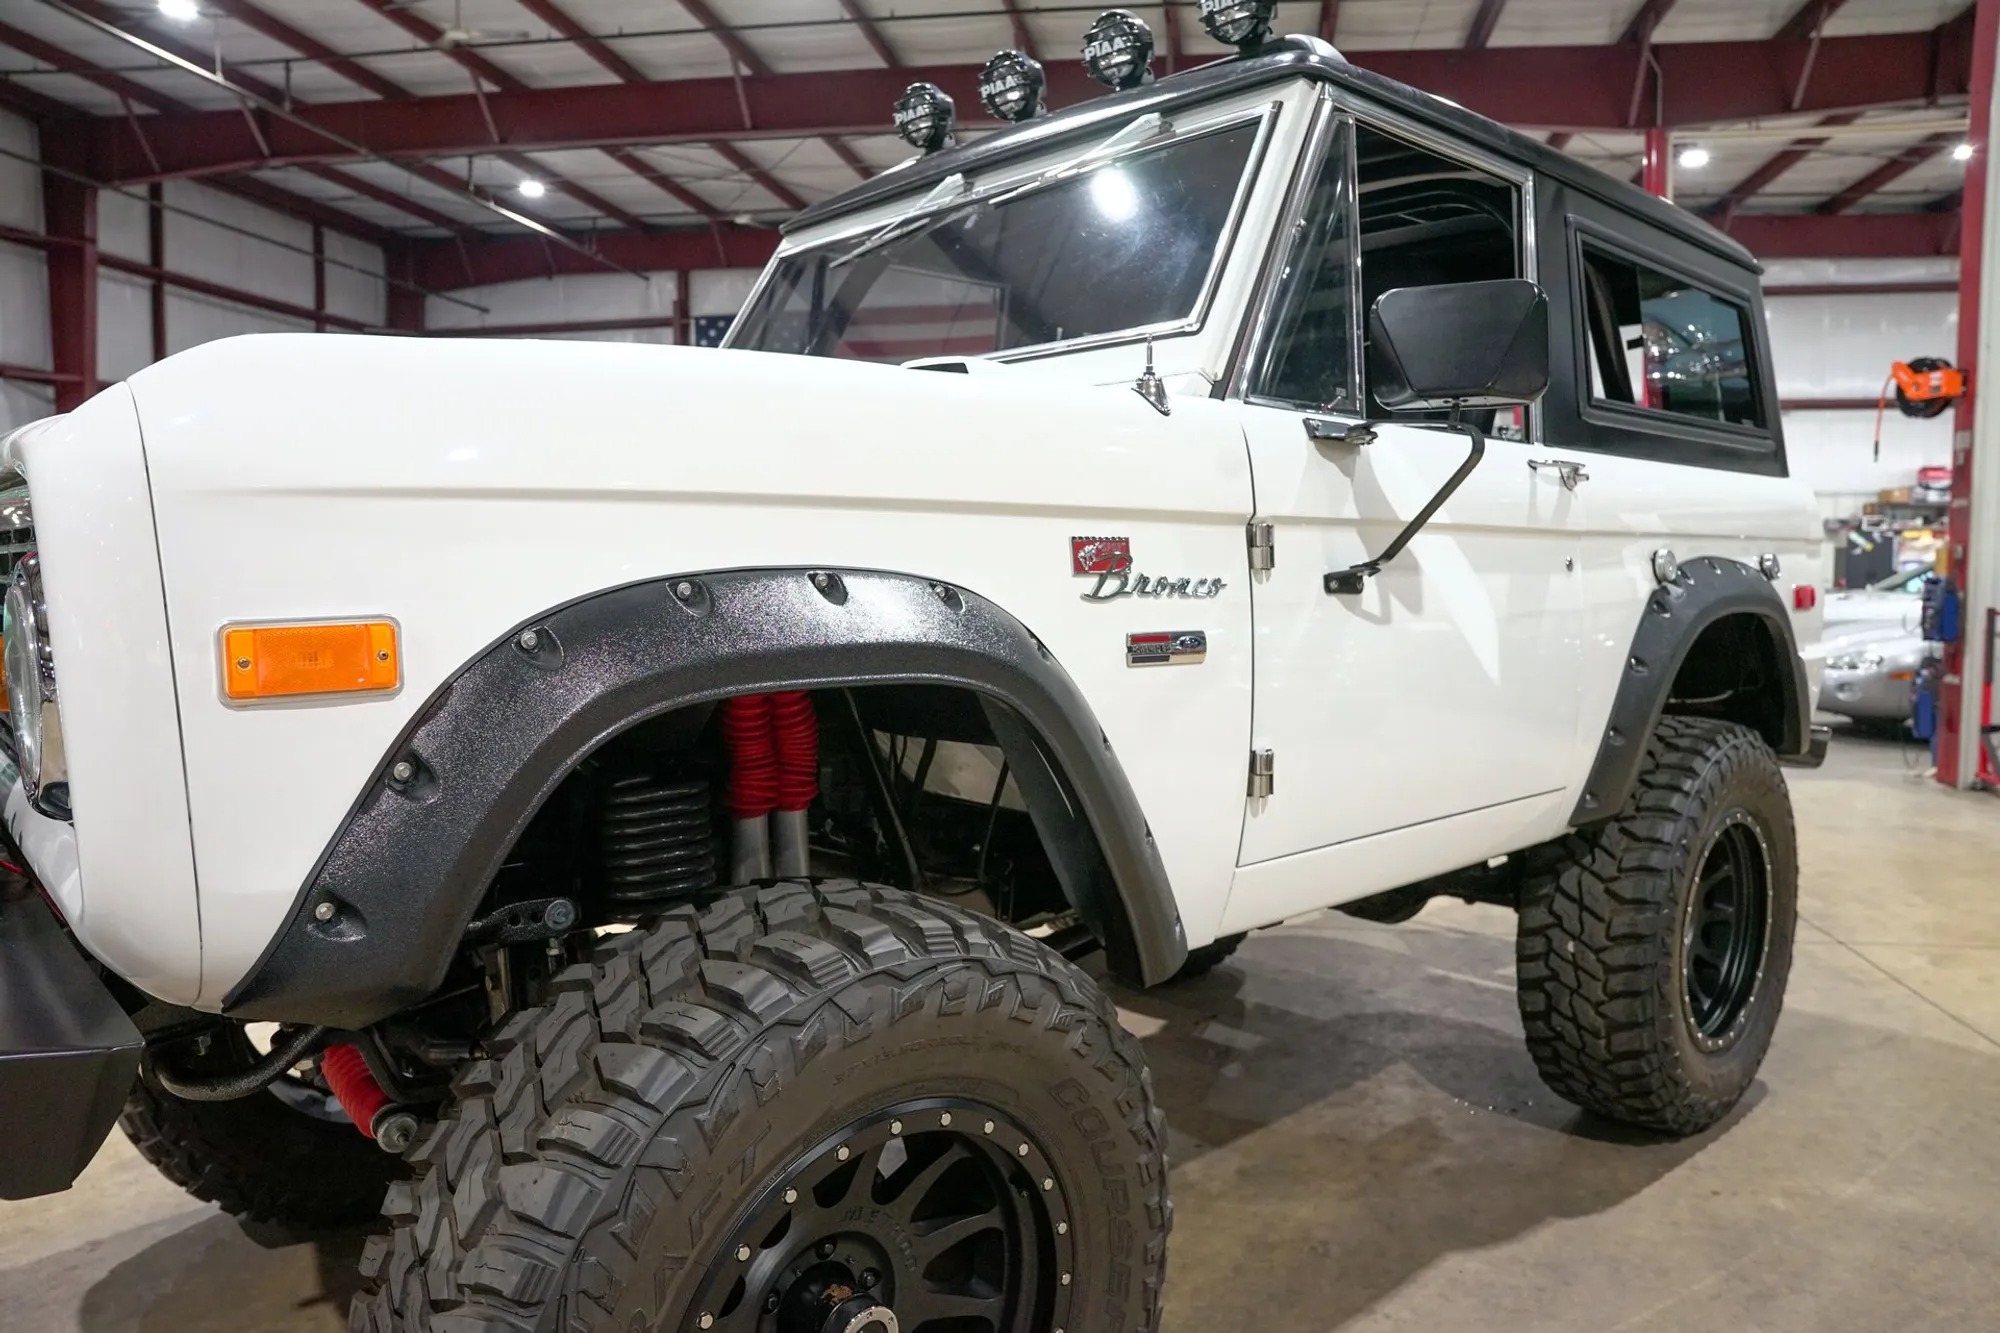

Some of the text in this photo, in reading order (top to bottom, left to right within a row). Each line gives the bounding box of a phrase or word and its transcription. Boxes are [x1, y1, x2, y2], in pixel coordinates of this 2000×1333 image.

[1201, 0, 1241, 16] PIA
[1084, 36, 1125, 61] PIAA
[980, 75, 1017, 98] PIAA
[892, 105, 926, 127] PIAA
[1081, 552, 1227, 601] Bronco
